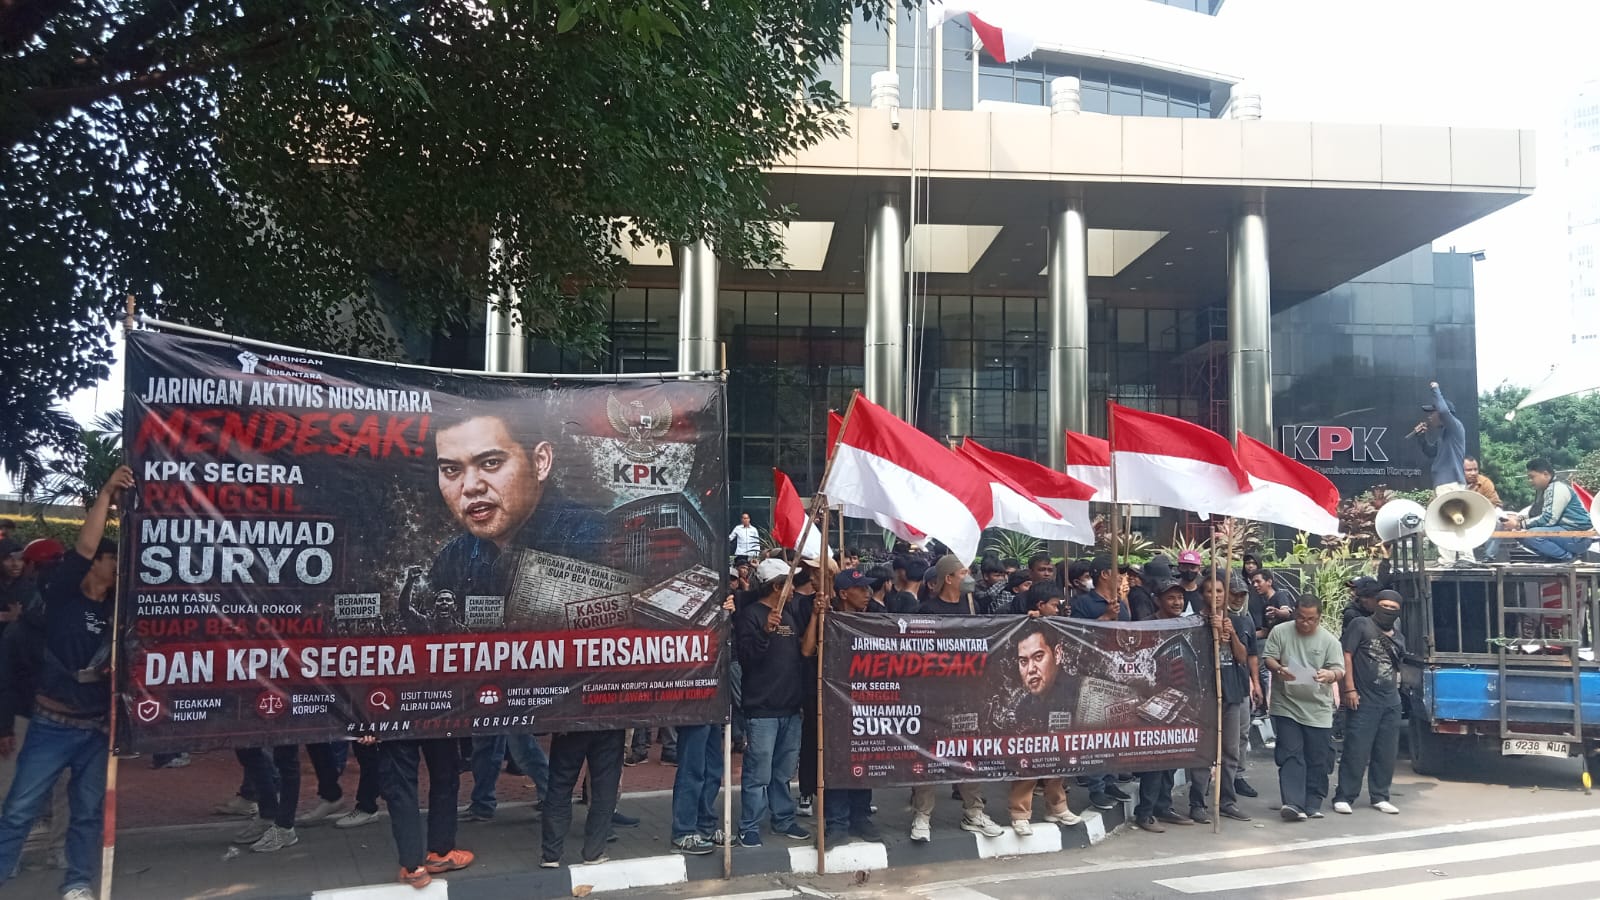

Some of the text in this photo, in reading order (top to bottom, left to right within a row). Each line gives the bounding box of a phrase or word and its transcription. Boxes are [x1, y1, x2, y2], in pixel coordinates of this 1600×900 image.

[266, 353, 323, 366] JARINGAN
[266, 368, 323, 380] NUSANTARA
[142, 377, 433, 413] JARINGAN AKTIVIS NUSANTARA
[135, 409, 429, 457] MENDESAK!
[1282, 425, 1389, 461] KPK
[144, 461, 304, 485] KPK SEGERA
[613, 463, 668, 486] KPK
[143, 484, 303, 513] PANGGIL
[141, 519, 335, 546] MUHAMMAD
[140, 546, 333, 584] SURYO
[537, 556, 565, 570] DUGAAN
[547, 568, 614, 591] SUAP BEA CUKAI
[137, 593, 221, 604] DALAM KASUS
[338, 597, 377, 606] BERANTAS
[137, 604, 302, 616] ALIRAN DANA CUKAI ROKOK
[339, 606, 376, 616] KORUPSI
[576, 599, 619, 617] KASUS
[573, 609, 630, 630] KORUPSI
[136, 617, 324, 638] SUAP BEA CUKAI
[851, 637, 988, 652] JARINGAN AKTIVIS NUSANTARA
[145, 635, 710, 686] DAN KPK SEGERA TETAPKAN TERSANGKA!
[850, 653, 987, 678] MENDESAK!
[1118, 662, 1141, 673] KPK
[507, 686, 570, 697] UNTUK INDONESIA
[582, 683, 620, 692] KEJAHATAN
[621, 681, 648, 690] KORUPSI
[649, 680, 674, 689] ADALAH
[675, 679, 694, 688] MUSUH
[851, 682, 900, 690] KPK SEGERA
[292, 694, 336, 704] BERANTAS
[401, 690, 452, 700] USUT TUNTAS
[507, 696, 553, 706] YANG BERSIH
[851, 691, 899, 700] PANGGIL
[174, 698, 222, 709] TEGAKKAN
[292, 705, 328, 715] KORUPSI
[400, 701, 452, 711] ALIRAN DANA
[173, 711, 207, 722] HUKUM
[852, 704, 921, 717] MUHAMMAD
[852, 716, 921, 736] SURYO
[935, 739, 967, 758] DAN
[972, 738, 1003, 756] KPK
[1007, 735, 1059, 755] SEGERA
[1063, 731, 1129, 752] TETAPKAN
[1133, 727, 1199, 747] TERSANGKA!
[1504, 742, 1511, 750] B
[1515, 742, 1540, 751] 9238
